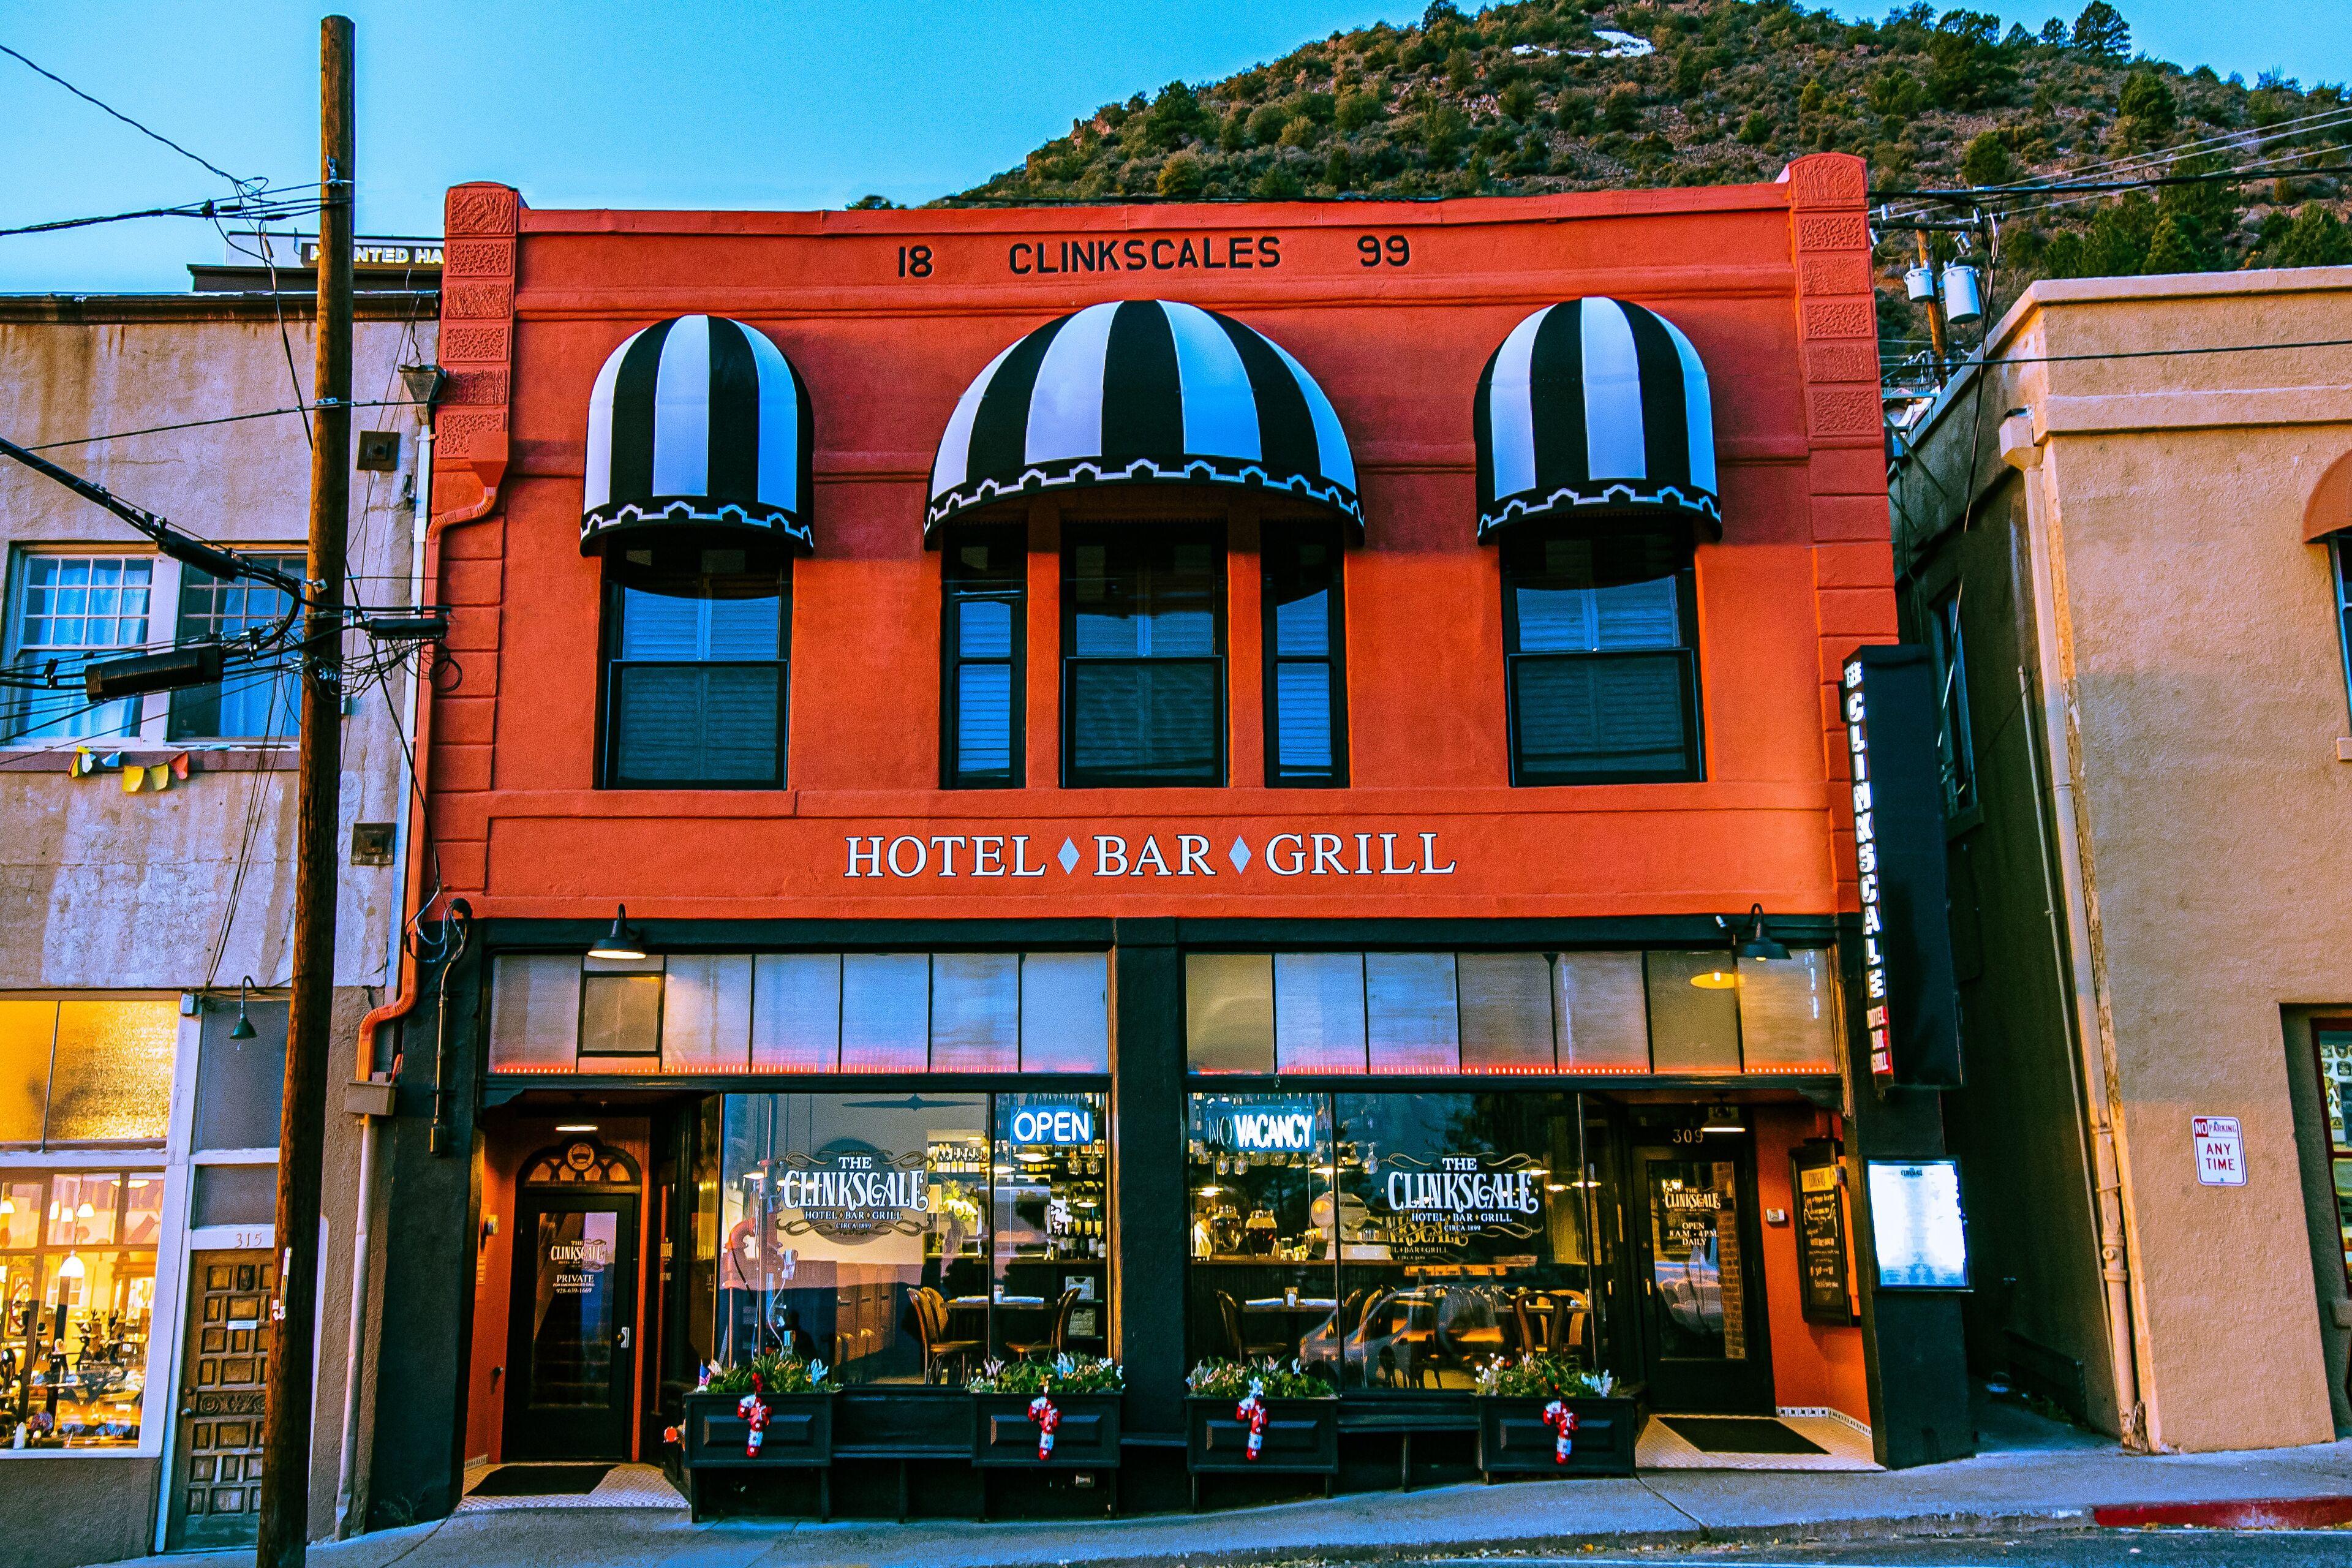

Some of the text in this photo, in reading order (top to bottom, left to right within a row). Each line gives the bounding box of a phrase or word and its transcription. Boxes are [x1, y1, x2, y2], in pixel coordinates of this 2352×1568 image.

[310, 245, 409, 263] HNTED
[898, 235, 1410, 278] 18 CLINKSCALES 99
[1847, 692, 1885, 998] CLINKSCALE
[843, 833, 1457, 878] HOTEL BAR GRILL
[1014, 1112, 1089, 1142] OPEN
[1208, 1114, 1313, 1148] NO VACANCY
[2195, 1121, 2237, 1134] NO PARKING
[1673, 1129, 1703, 1143] 309
[2207, 1142, 2230, 1155] ANY
[838, 1156, 872, 1169] THE
[1442, 1157, 1477, 1170] THE
[2206, 1158, 2235, 1170] TIME
[783, 1170, 929, 1212] CLINKSCALE
[1387, 1171, 1539, 1214] CLINKSCALE
[1665, 1193, 1721, 1209] CLINKSCALE
[805, 1210, 903, 1220] HOTEL BAR GRILL
[1411, 1213, 1512, 1223] HOTEL BAR GRILL
[235, 1232, 262, 1249] 315
